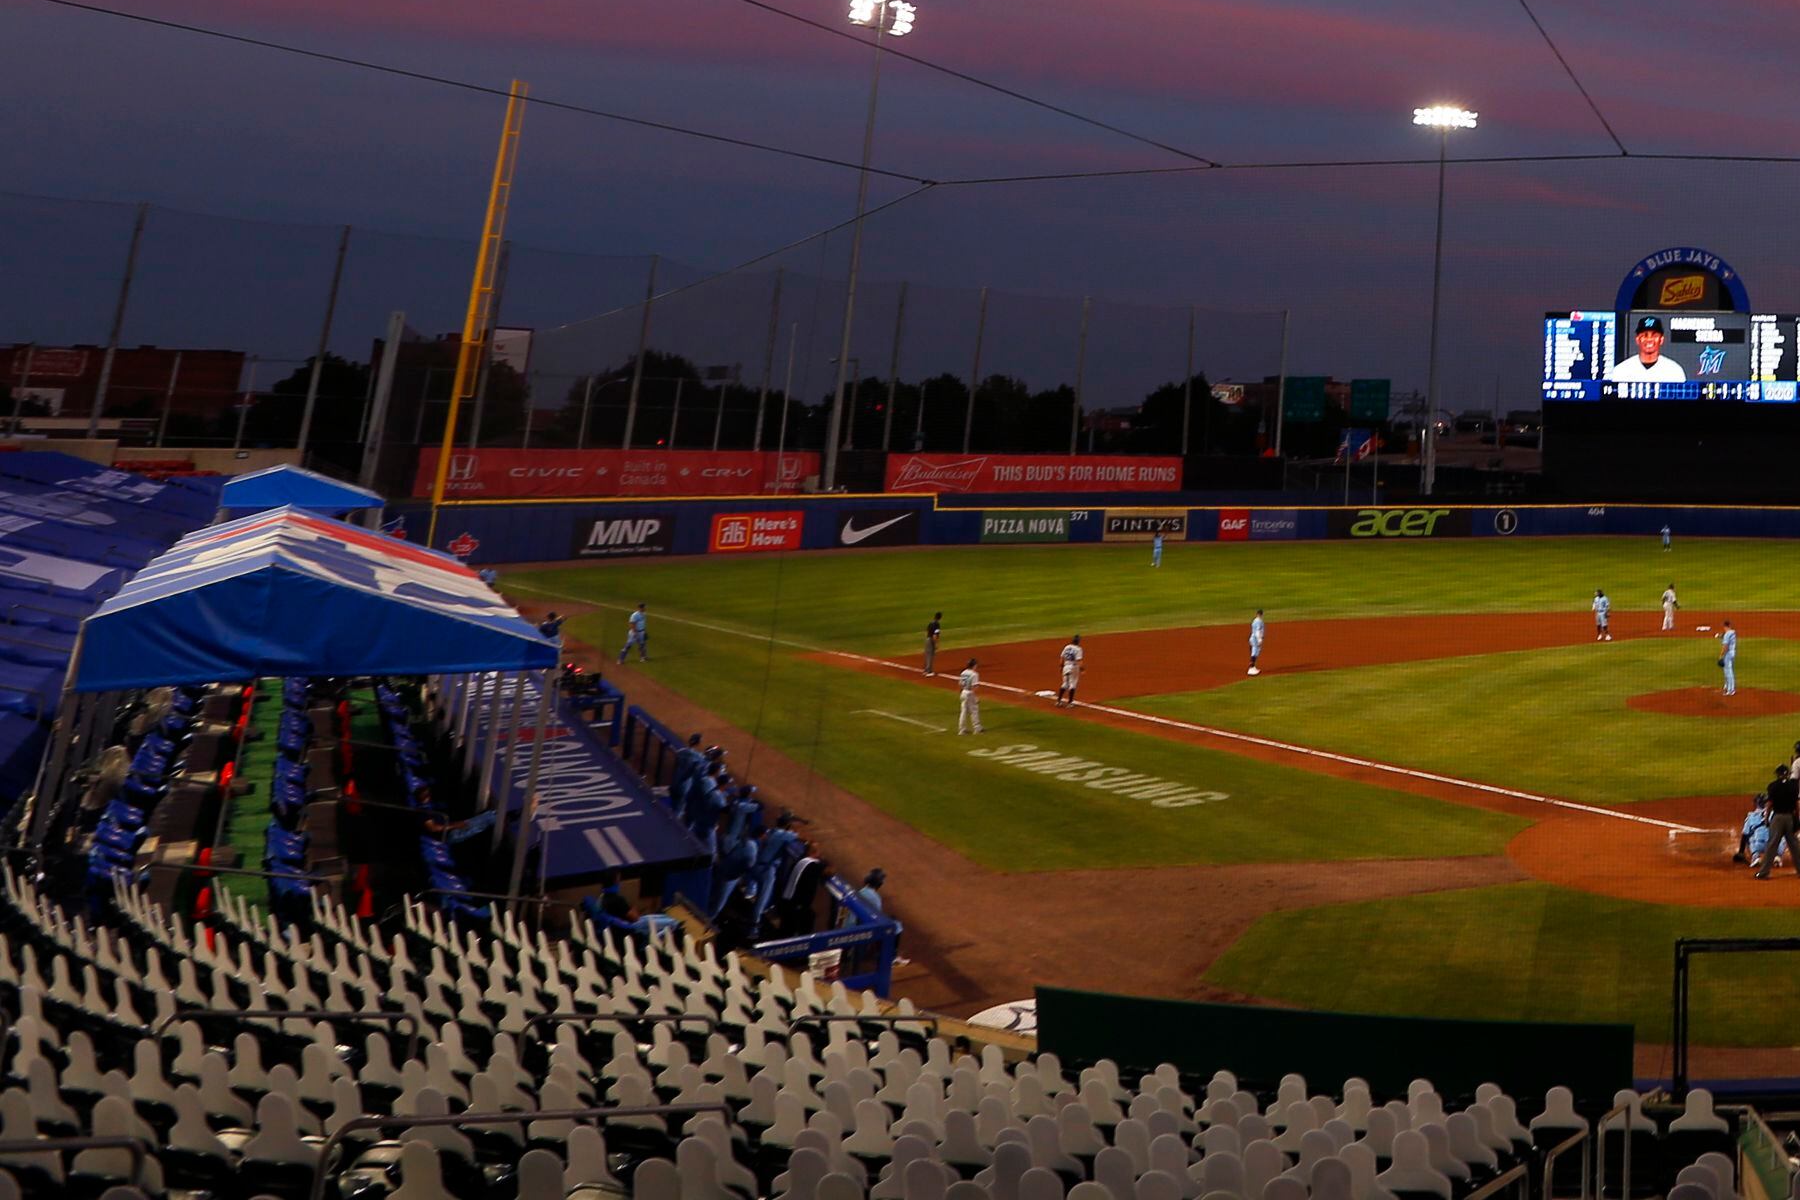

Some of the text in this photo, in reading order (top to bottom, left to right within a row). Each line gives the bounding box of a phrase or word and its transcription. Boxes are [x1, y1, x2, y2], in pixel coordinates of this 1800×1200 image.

[1646, 250, 1720, 270] BLUE JAYS
[508, 467, 585, 478] CIVIC
[623, 460, 667, 472] Built in
[701, 468, 753, 477] CR-V
[904, 464, 977, 481] Budweiser
[993, 465, 1176, 482] THIS BUD'S FOR HOME RUNS
[619, 473, 667, 486] Canada
[753, 516, 798, 531] Here's
[1070, 511, 1089, 521] 371
[1350, 509, 1450, 536] acer
[983, 517, 1064, 536] PIZZA NOVA
[1110, 518, 1181, 532] PINTY'S
[1221, 519, 1248, 530] GAF
[587, 519, 661, 546] MNP
[966, 743, 1230, 808] SAMSUNG
[827, 931, 873, 946] SAMSUNG
[763, 942, 810, 957] SAMSUNG
